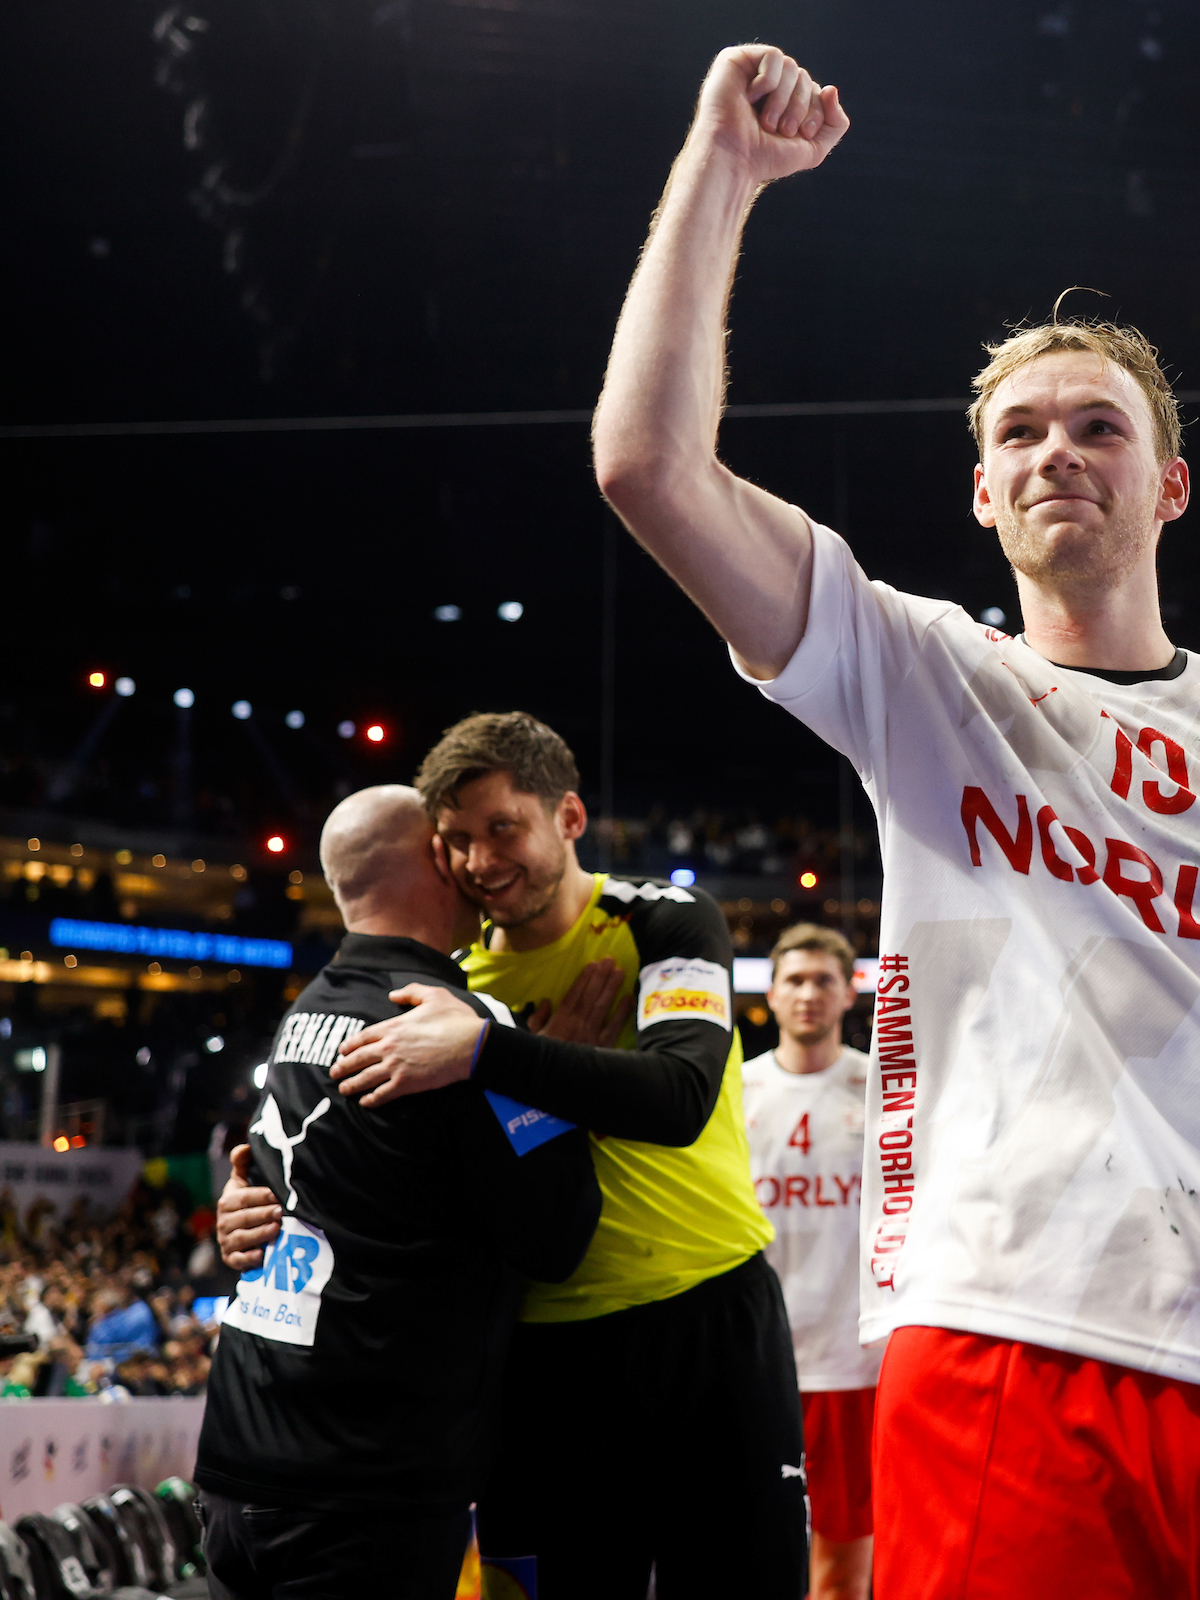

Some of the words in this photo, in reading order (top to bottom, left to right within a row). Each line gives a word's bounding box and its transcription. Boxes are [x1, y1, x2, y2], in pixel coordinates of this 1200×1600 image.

[1101, 709, 1197, 815] 19
[644, 992, 725, 1016] Josera
[788, 1112, 813, 1157] 4
[754, 1174, 861, 1209] ORLY
[241, 1229, 320, 1294] KB
